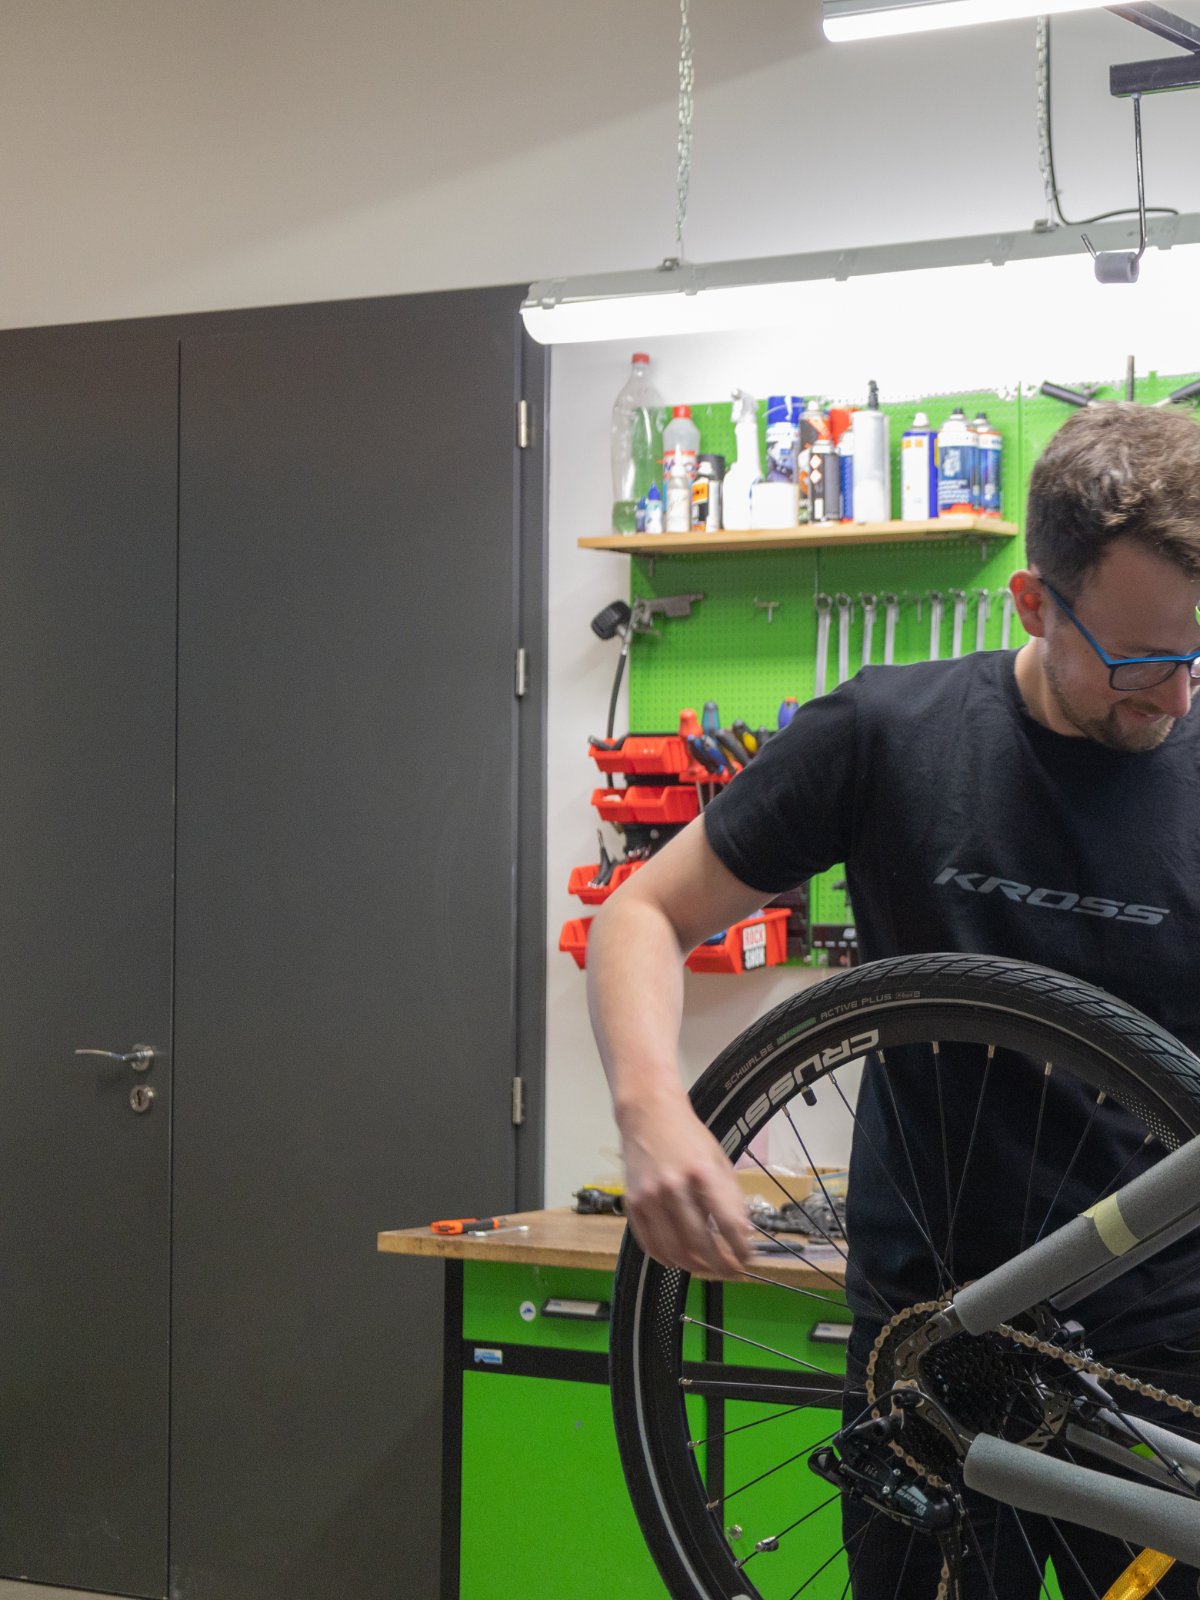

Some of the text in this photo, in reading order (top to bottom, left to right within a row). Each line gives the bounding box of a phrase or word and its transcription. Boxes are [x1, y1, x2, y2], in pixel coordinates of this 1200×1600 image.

[933, 867, 1170, 926] KROSS
[820, 1001, 858, 1021] ACTIVE
[860, 993, 893, 1007] PLUS
[724, 1042, 775, 1101] SCHWALBE
